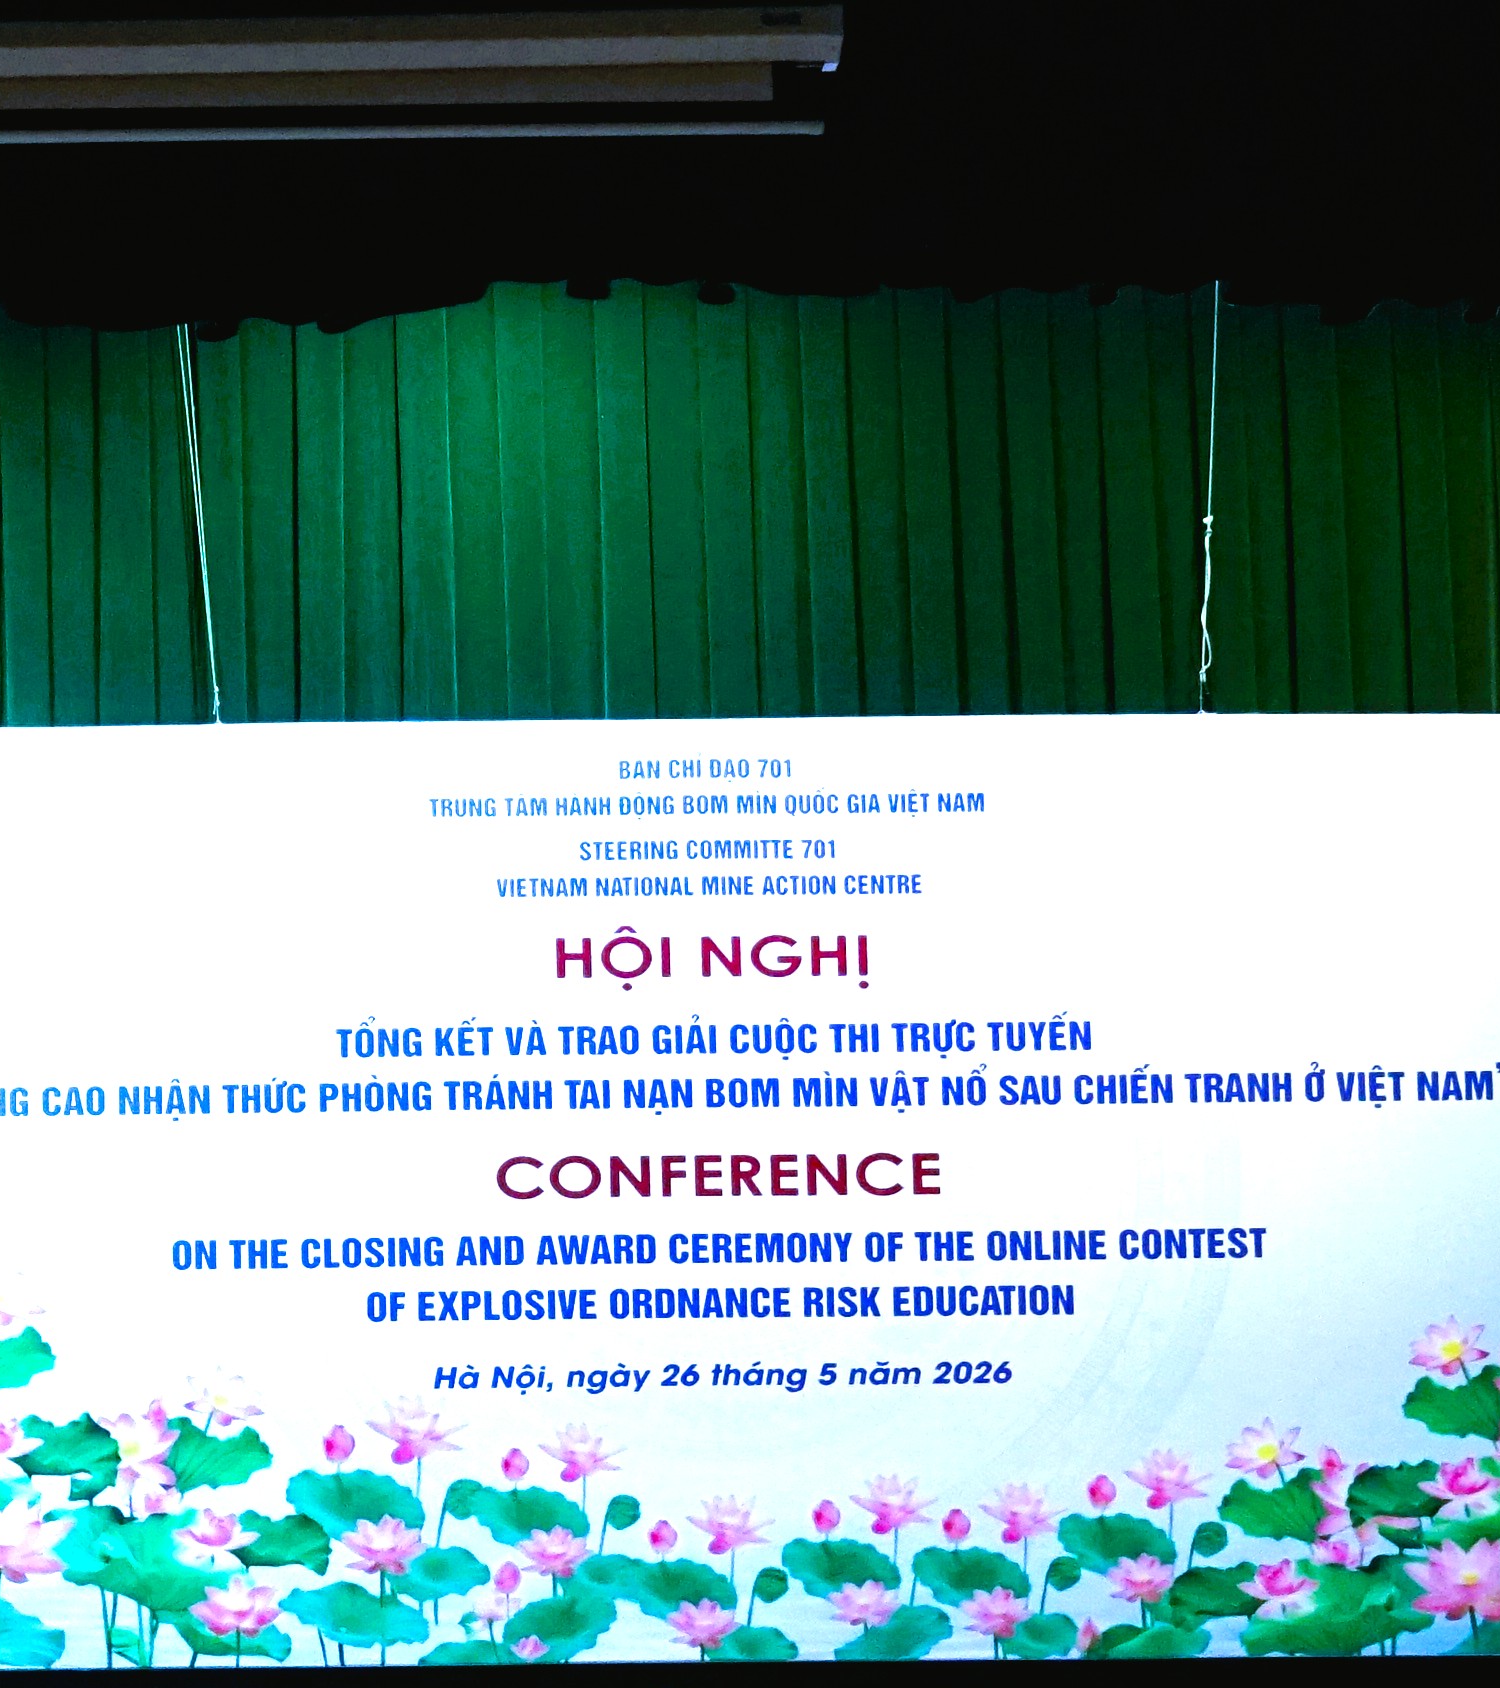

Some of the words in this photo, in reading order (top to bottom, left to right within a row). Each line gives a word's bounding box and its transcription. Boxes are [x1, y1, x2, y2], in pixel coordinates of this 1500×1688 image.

[619, 760, 661, 780] BAN
[757, 758, 791, 779] 701
[429, 797, 497, 818] TRUNG
[682, 794, 729, 815] BOM
[736, 790, 777, 815] MÌN
[847, 793, 881, 814] GIA
[887, 788, 930, 818] VIỆT
[937, 792, 985, 813] NAM
[579, 839, 679, 862] STEERING
[686, 839, 794, 860] COMMITTE
[801, 839, 836, 859] 701
[496, 877, 588, 898] VIETNAM
[595, 876, 694, 897] NATIONAL
[701, 875, 754, 896] MINE
[761, 875, 837, 896] ACTION
[843, 873, 922, 895] CENTRE
[555, 925, 672, 992] HỘI
[700, 934, 870, 990] NGHỊ
[335, 1015, 423, 1059] TỔNG
[434, 1016, 494, 1057] KẾT
[504, 1019, 547, 1056] VÀ
[557, 1024, 640, 1056] TRAO
[651, 1013, 717, 1055] GIẢI
[729, 1017, 818, 1061] CUỘC
[828, 1022, 880, 1054] THI
[890, 1018, 976, 1060] TRỰC
[986, 1010, 1092, 1052] TUYẾN
[41, 1085, 106, 1117] CAO
[118, 1078, 211, 1122] NHẬN
[221, 1077, 307, 1114] THỨC
[318, 1074, 432, 1113] PHÒNG
[443, 1073, 553, 1111] TRÁNH
[563, 1079, 611, 1110] TAI
[623, 1078, 693, 1116] NẠN
[705, 1077, 780, 1109] BOM
[792, 1070, 858, 1108] MÌN
[869, 1069, 930, 1114] VẬT
[941, 1062, 988, 1107] NỔ
[998, 1074, 1062, 1106] SAU
[1073, 1063, 1174, 1105] CHIẾN
[1183, 1071, 1293, 1104] TRANH
[1304, 1061, 1326, 1103] Ở
[1335, 1064, 1406, 1108] VIỆT
[496, 1152, 941, 1200] CONFERENCE
[172, 1239, 218, 1271] ON
[228, 1238, 289, 1270] THE
[300, 1236, 444, 1270] CLOSING
[455, 1235, 525, 1267] AND
[535, 1233, 657, 1266] AWARD
[668, 1231, 853, 1265] CEREMONY
[864, 1231, 904, 1263] OF
[913, 1230, 975, 1262] THE
[986, 1229, 1107, 1262] ONLINE
[1118, 1227, 1267, 1261] CONTEST
[366, 1291, 406, 1323] OF
[417, 1289, 598, 1322] EXPLOSIVE
[609, 1286, 792, 1320] ORDNANCE
[803, 1286, 882, 1318] RISK
[892, 1284, 1075, 1317] EDUCATION
[433, 1364, 480, 1390] Hà
[490, 1363, 554, 1396] Nội,
[566, 1362, 651, 1395] ngày
[660, 1363, 701, 1387] 26
[711, 1360, 808, 1393] tháng
[817, 1362, 838, 1387] 5
[848, 1360, 922, 1386] năm
[931, 1360, 1013, 1385] 2026
